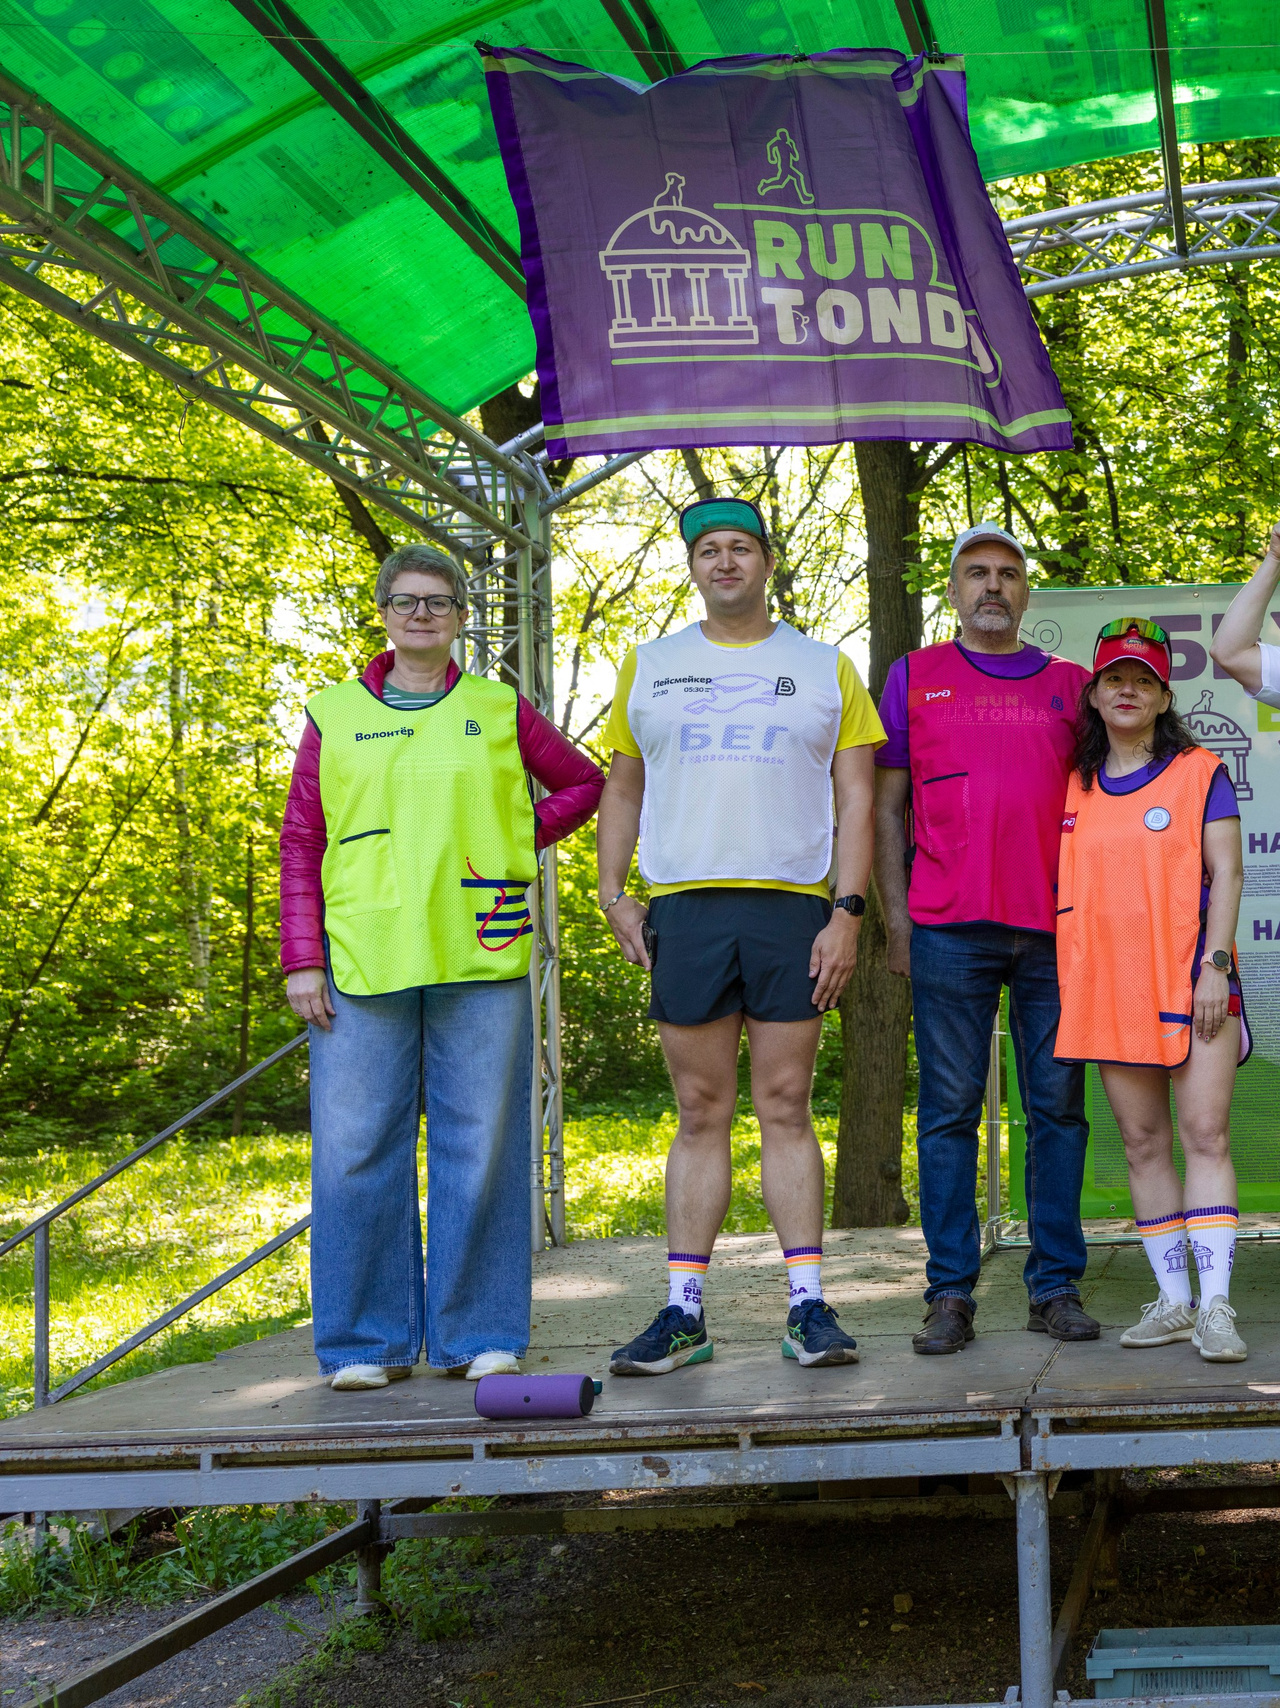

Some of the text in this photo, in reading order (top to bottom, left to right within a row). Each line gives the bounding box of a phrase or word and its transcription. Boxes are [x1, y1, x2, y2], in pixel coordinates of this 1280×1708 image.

[753, 219, 915, 280] RUN
[652, 675, 713, 689] Пейсмейкер
[652, 689, 669, 698] 27:30
[974, 695, 1020, 707] RUN
[974, 707, 1053, 723] TONDA
[355, 727, 415, 742] Волонтёр
[679, 723, 789, 752] БЕГ
